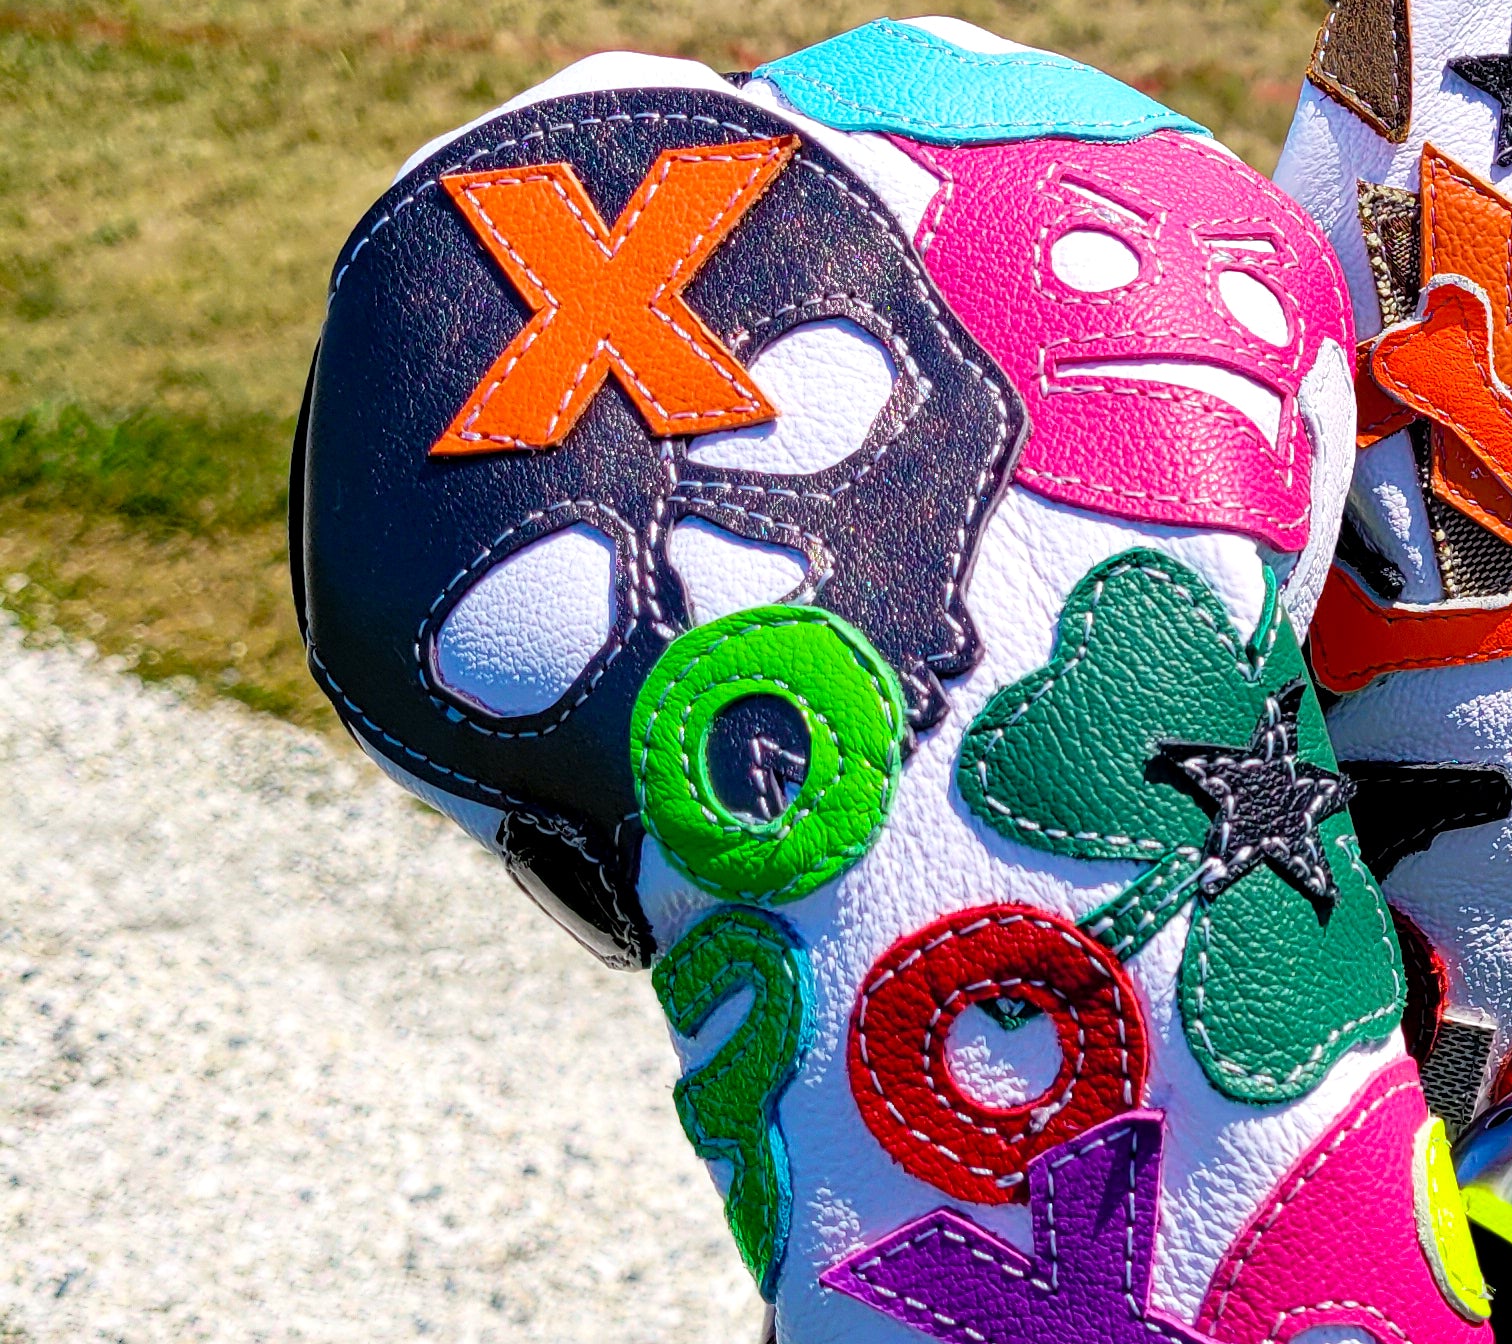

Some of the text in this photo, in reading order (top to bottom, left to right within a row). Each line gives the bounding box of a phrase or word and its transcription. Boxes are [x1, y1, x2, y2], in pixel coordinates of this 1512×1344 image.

[430, 135, 802, 457] X
[630, 603, 906, 906] O
[847, 903, 1150, 1204] O
